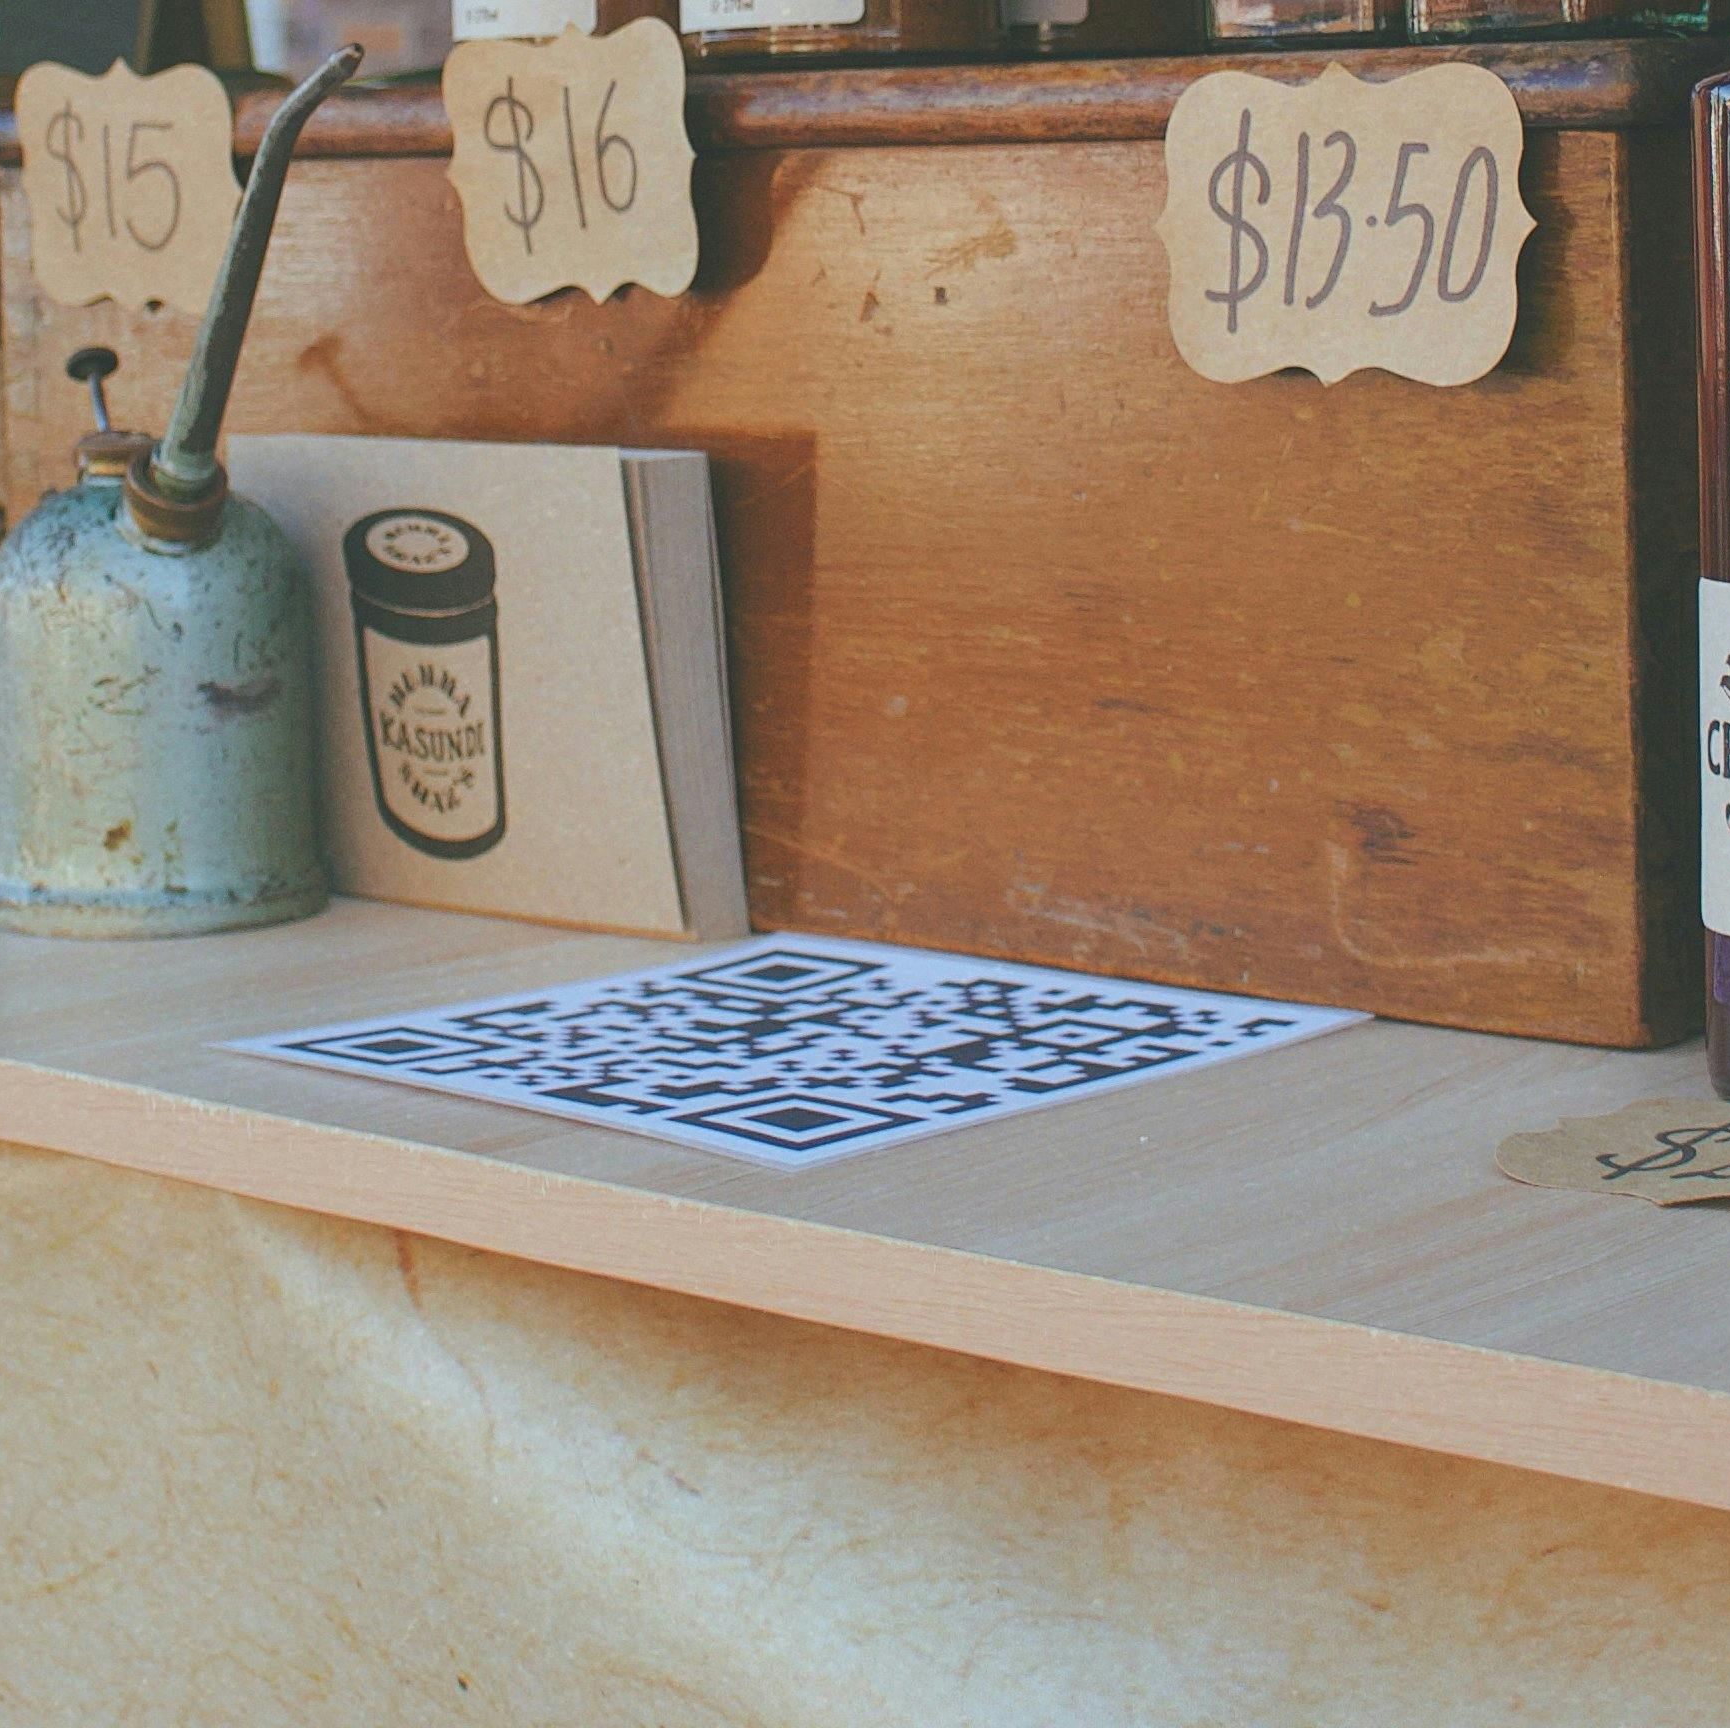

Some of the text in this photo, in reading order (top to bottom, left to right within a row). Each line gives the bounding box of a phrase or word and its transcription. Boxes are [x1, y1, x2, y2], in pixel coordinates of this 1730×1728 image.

[47, 102, 181, 253] $15
[483, 75, 639, 255] $16
[1204, 108, 1499, 334] $13.50
[378, 710, 486, 762] KASUNDI
